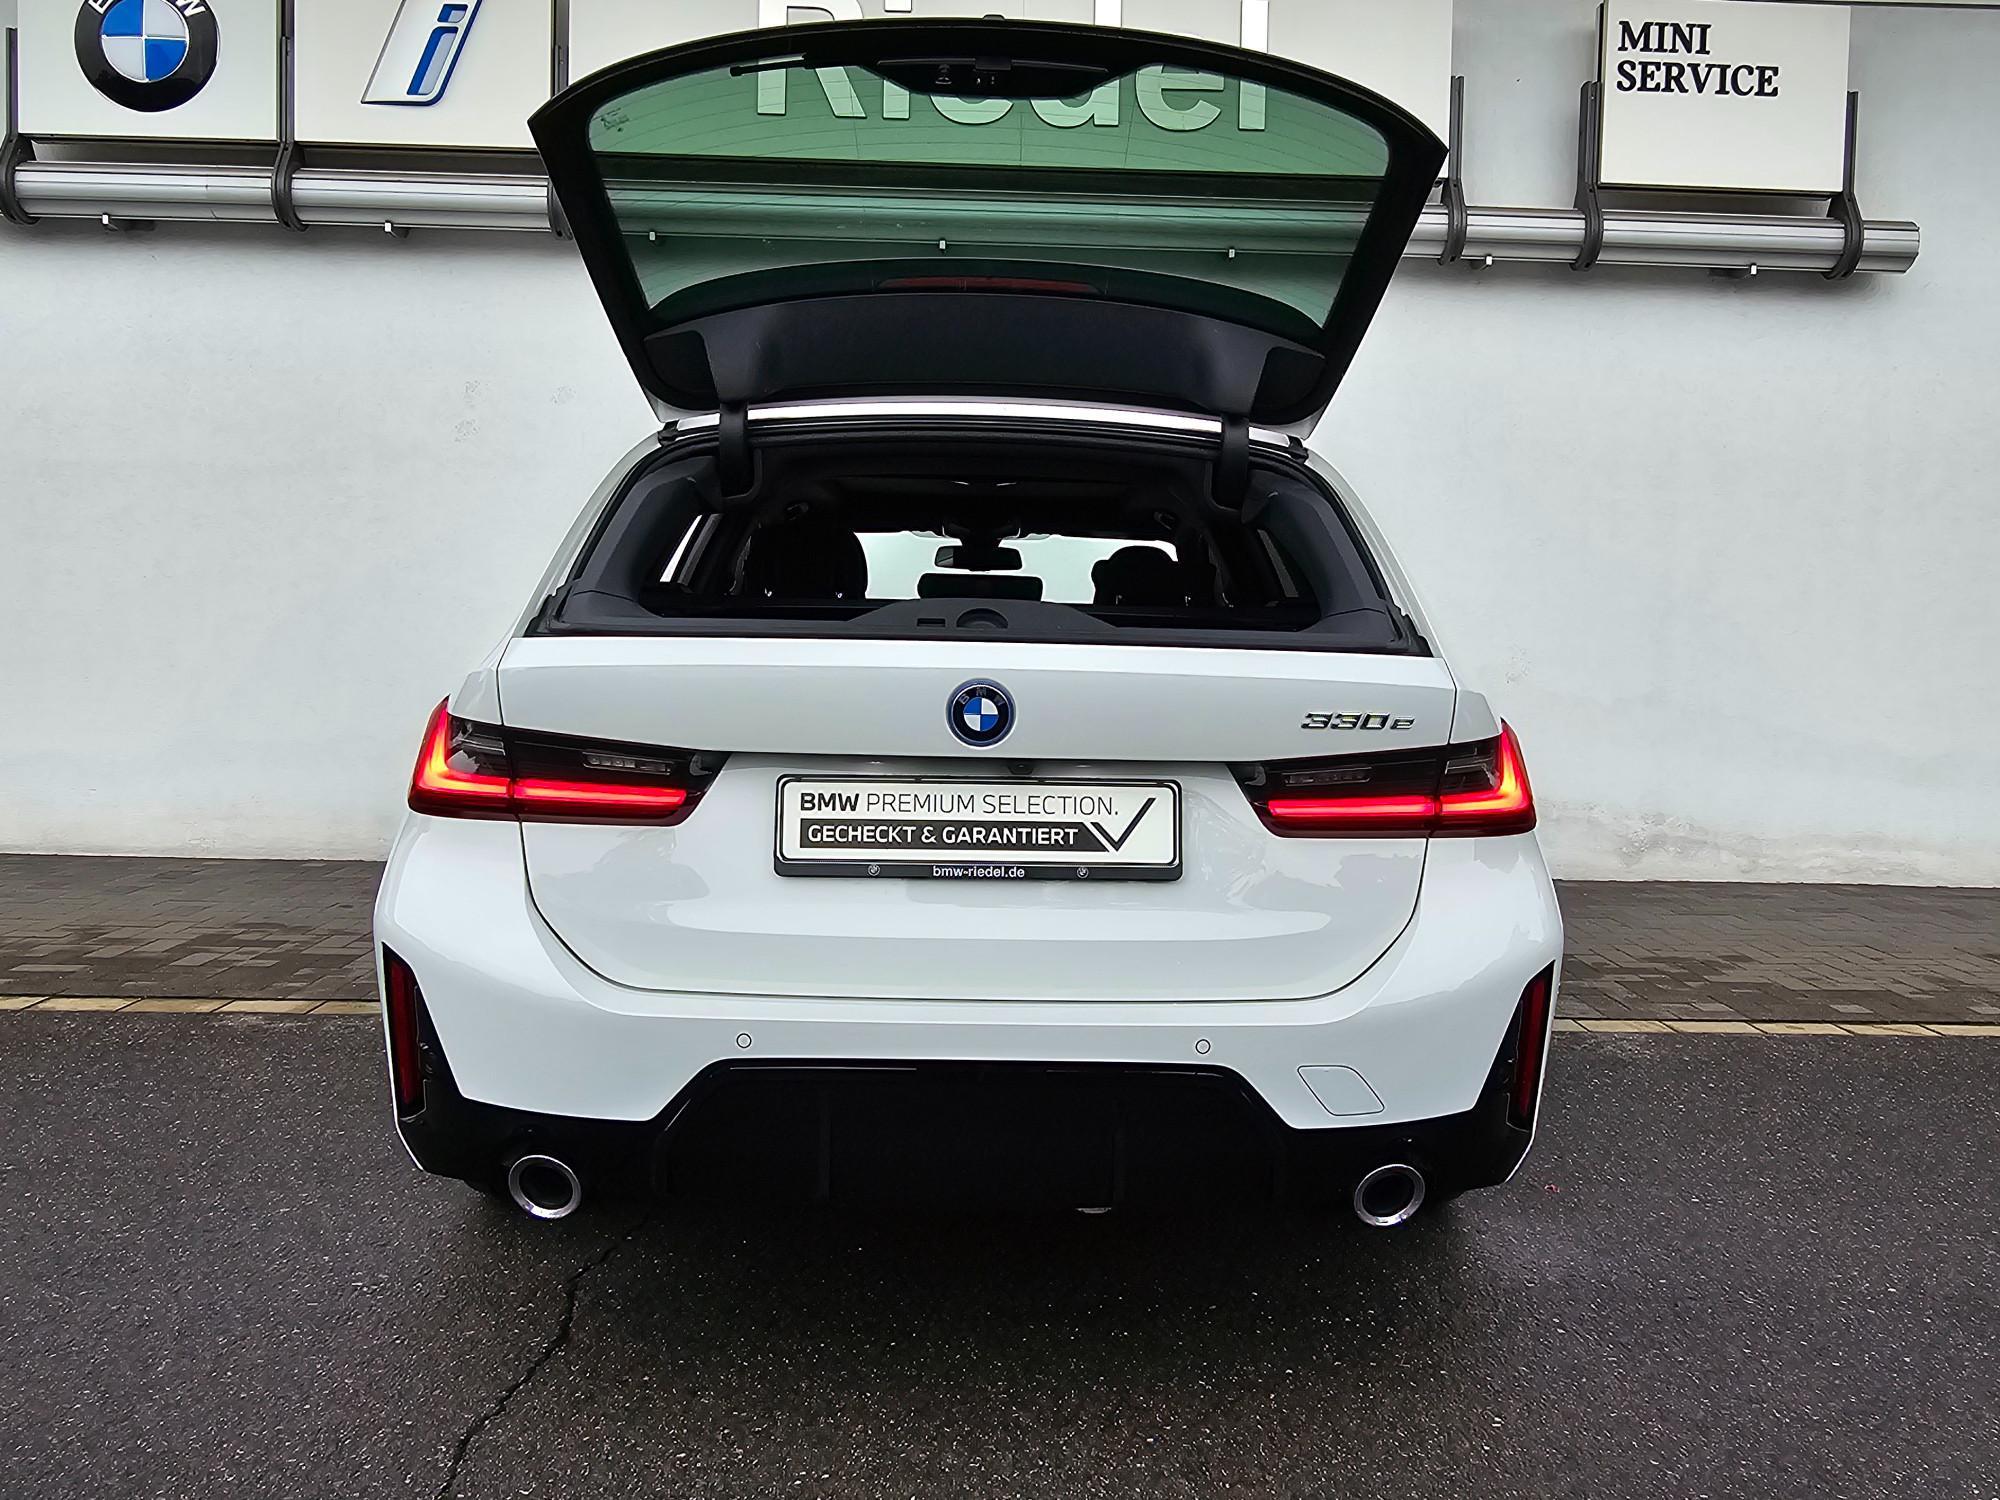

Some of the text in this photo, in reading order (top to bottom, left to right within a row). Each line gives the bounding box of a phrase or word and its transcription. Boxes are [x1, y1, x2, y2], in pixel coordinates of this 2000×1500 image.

[1617, 20, 1712, 55] MINI
[1616, 60, 1779, 97] SERVICE
[1300, 711, 1416, 730] 330e
[800, 792, 1119, 816] BMW PREMIUM SELECTION.
[808, 825, 1079, 845] GECHECKT & GARANTIERT
[932, 864, 1025, 879] bmw-riedel.de
